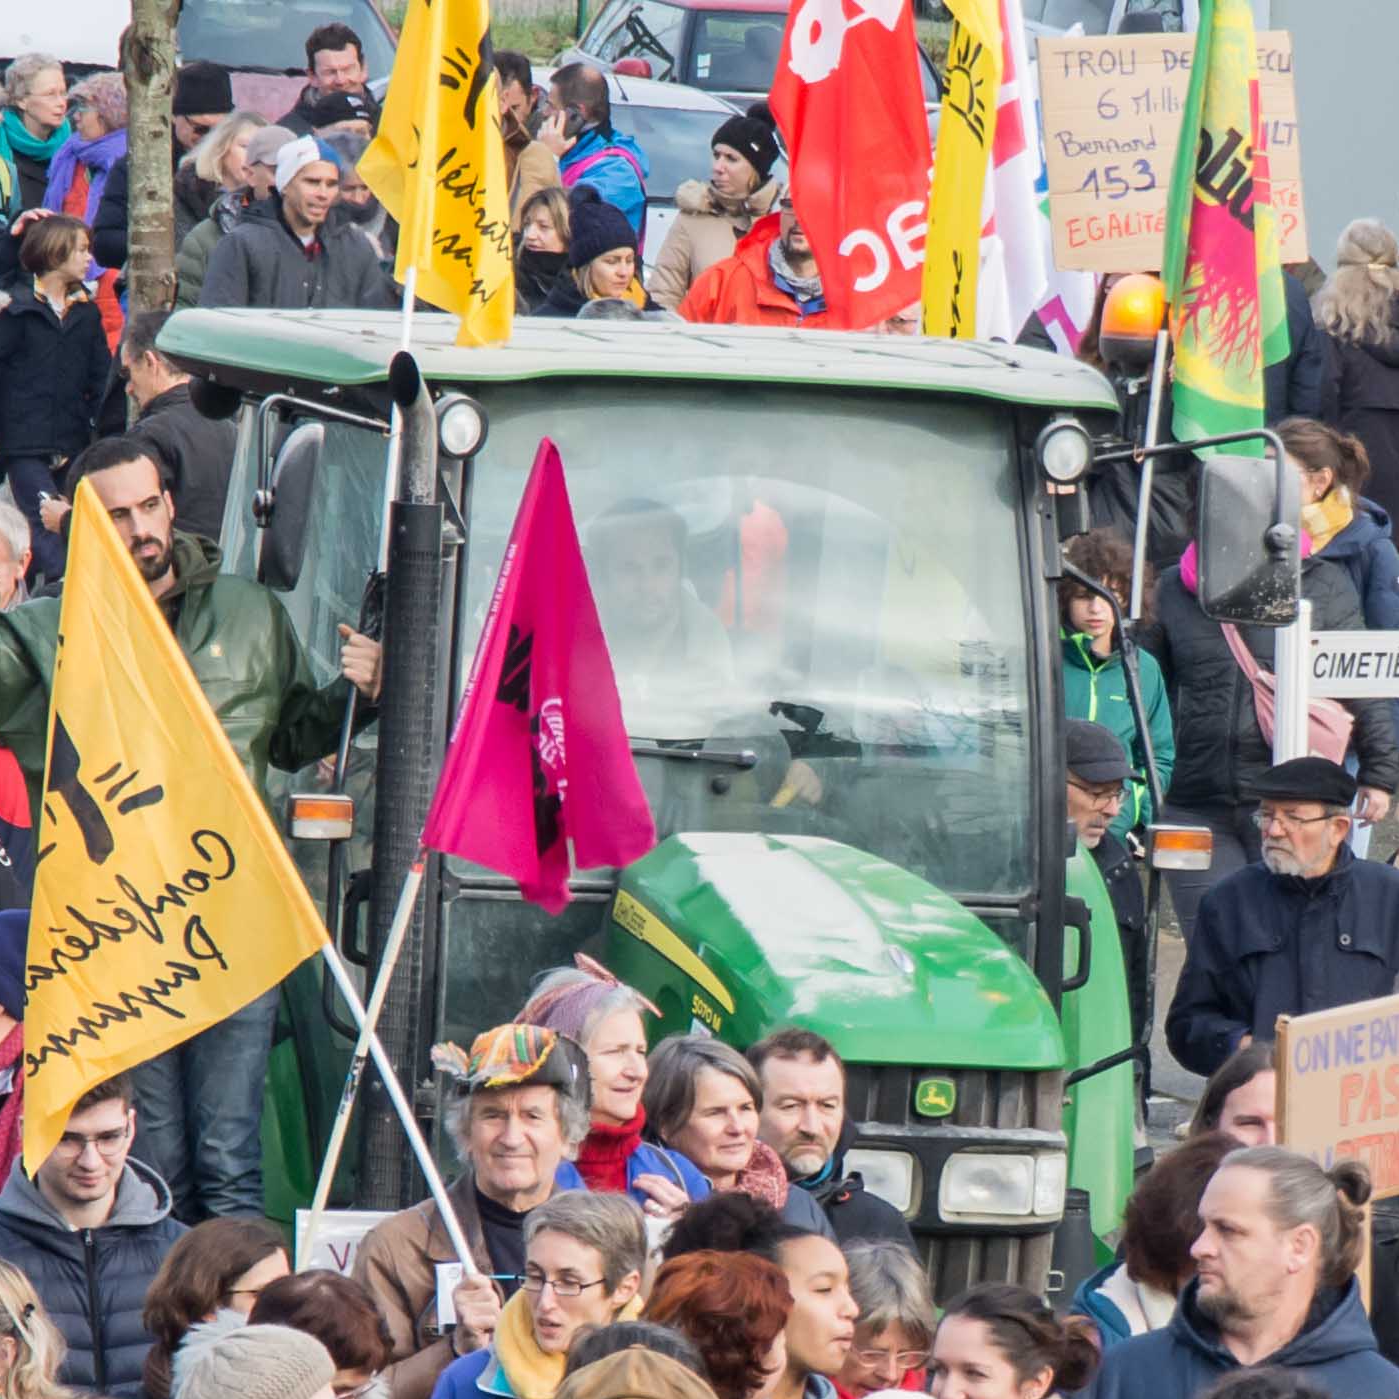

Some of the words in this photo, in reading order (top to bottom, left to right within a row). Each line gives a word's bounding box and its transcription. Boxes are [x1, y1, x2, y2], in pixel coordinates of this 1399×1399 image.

[1054, 49, 1135, 78] TROU
[1097, 87, 1119, 120] 6
[1082, 158, 1157, 199] 153
